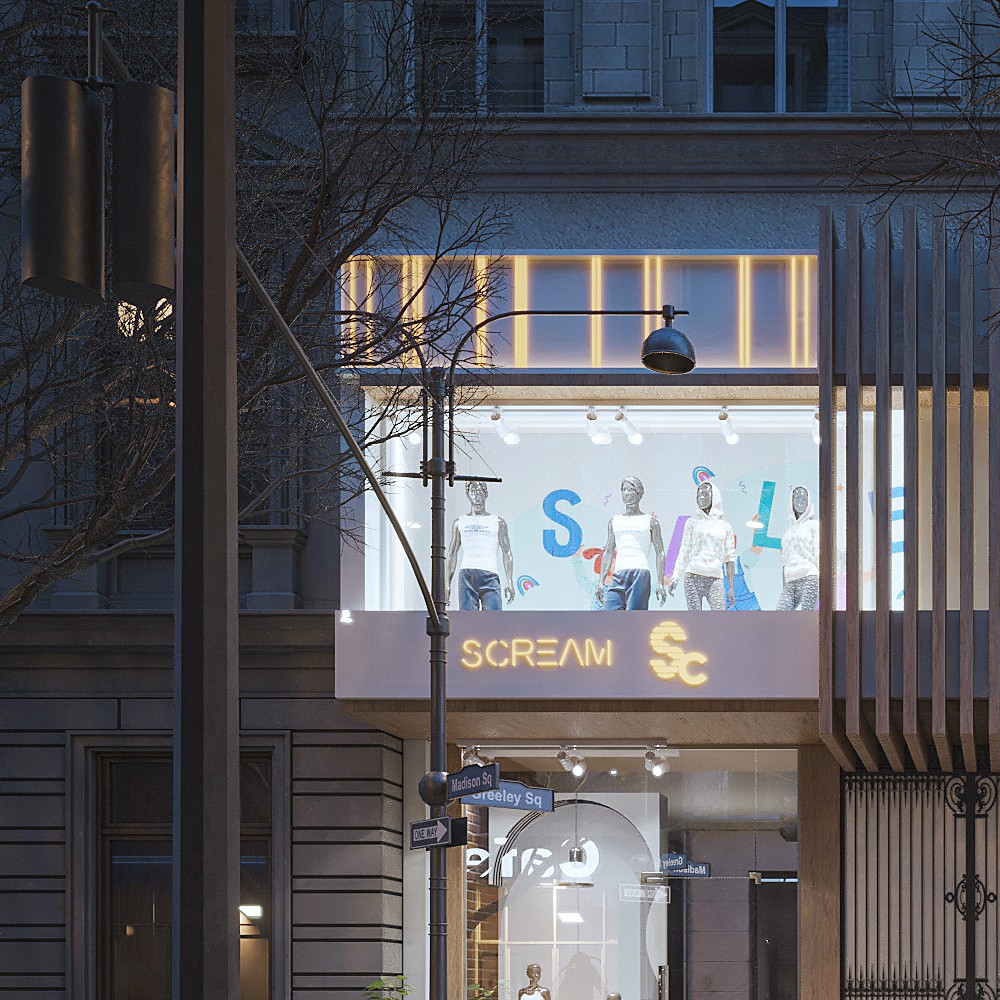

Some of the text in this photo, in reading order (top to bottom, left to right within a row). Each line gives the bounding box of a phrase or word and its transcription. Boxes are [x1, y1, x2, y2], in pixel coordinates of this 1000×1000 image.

[461, 638, 612, 667] SCREAM
[451, 772, 492, 792] Madison Sq
[525, 792, 542, 808] Sq
[415, 826, 438, 840] ONE WAY
